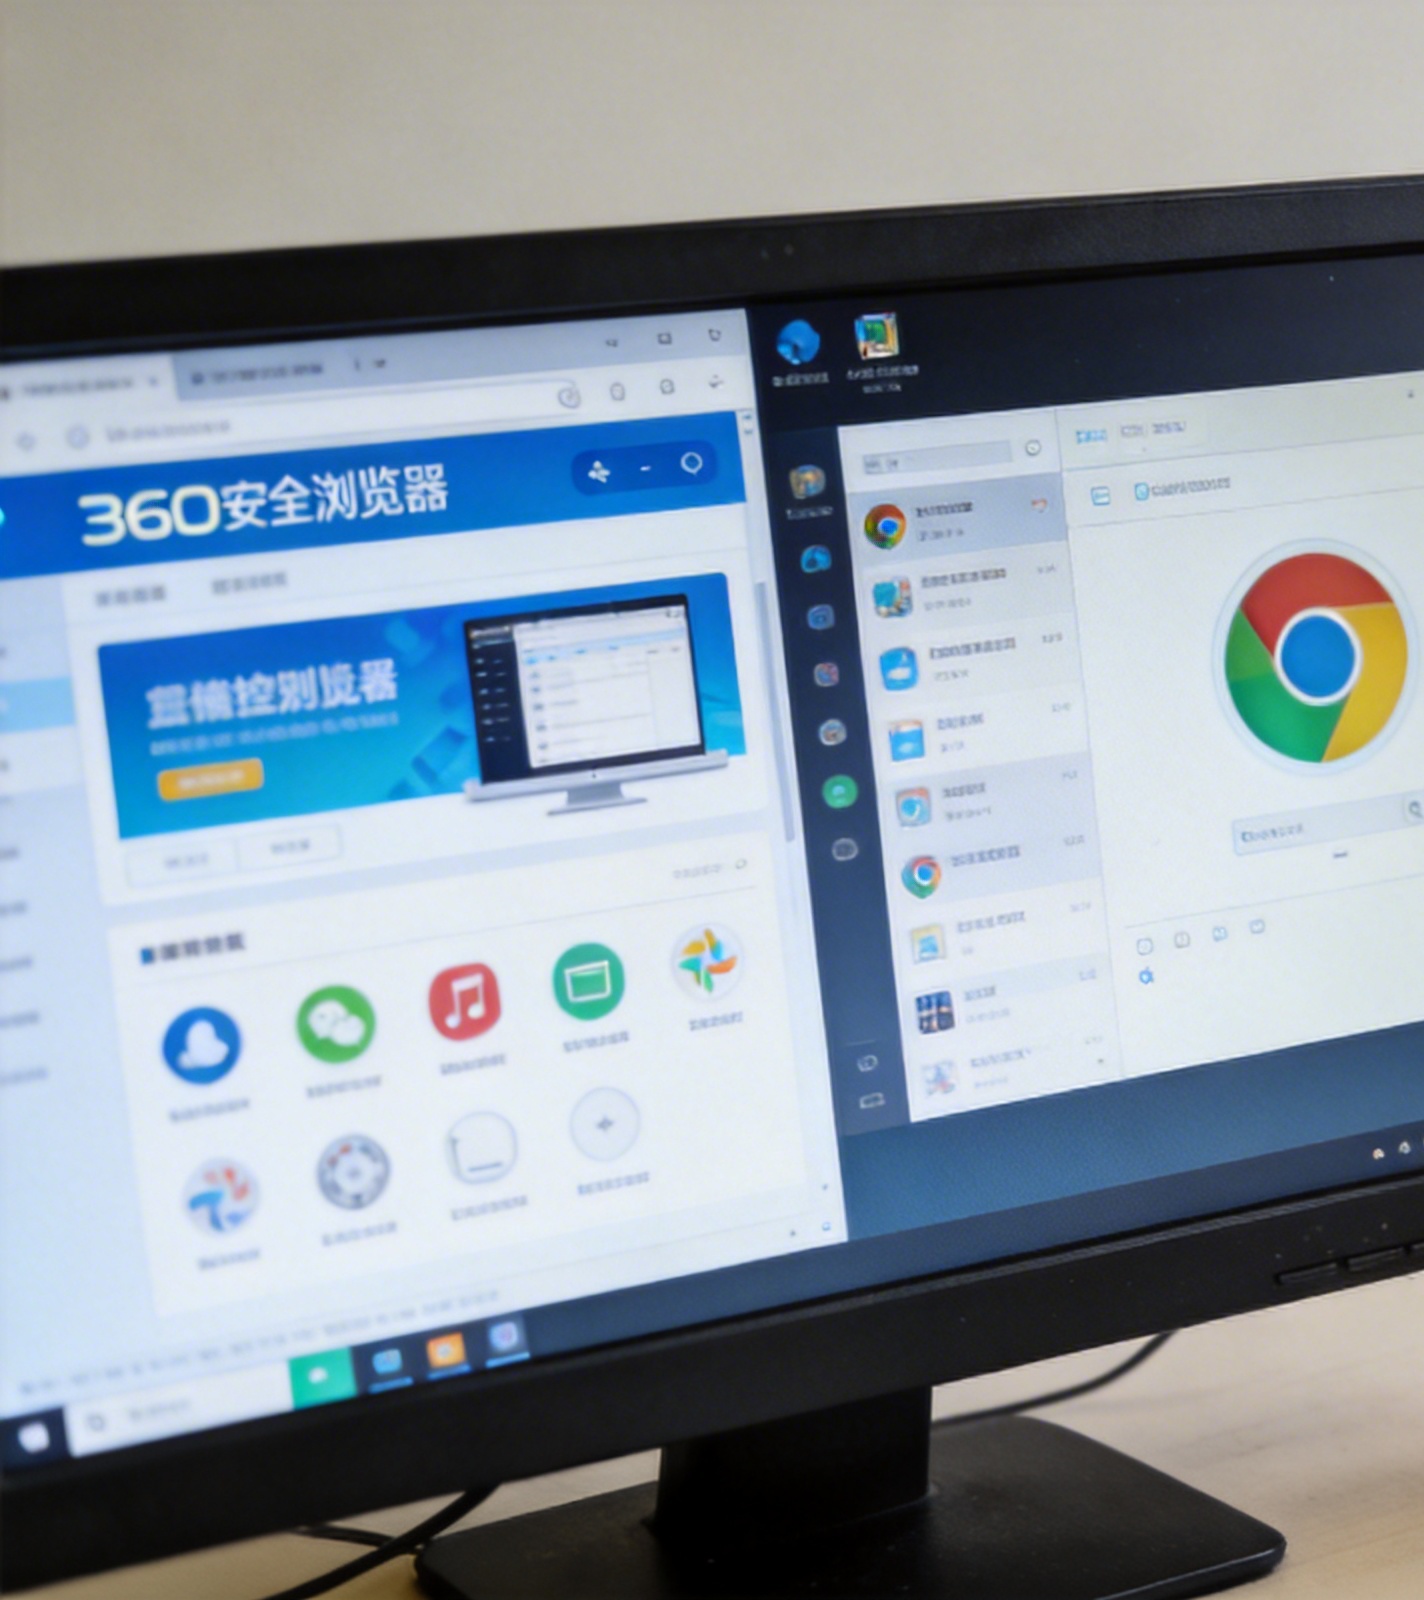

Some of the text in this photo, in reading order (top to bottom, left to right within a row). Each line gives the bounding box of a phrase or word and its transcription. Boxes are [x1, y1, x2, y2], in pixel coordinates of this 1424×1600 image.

[78, 463, 448, 547] 360安全浏览器
